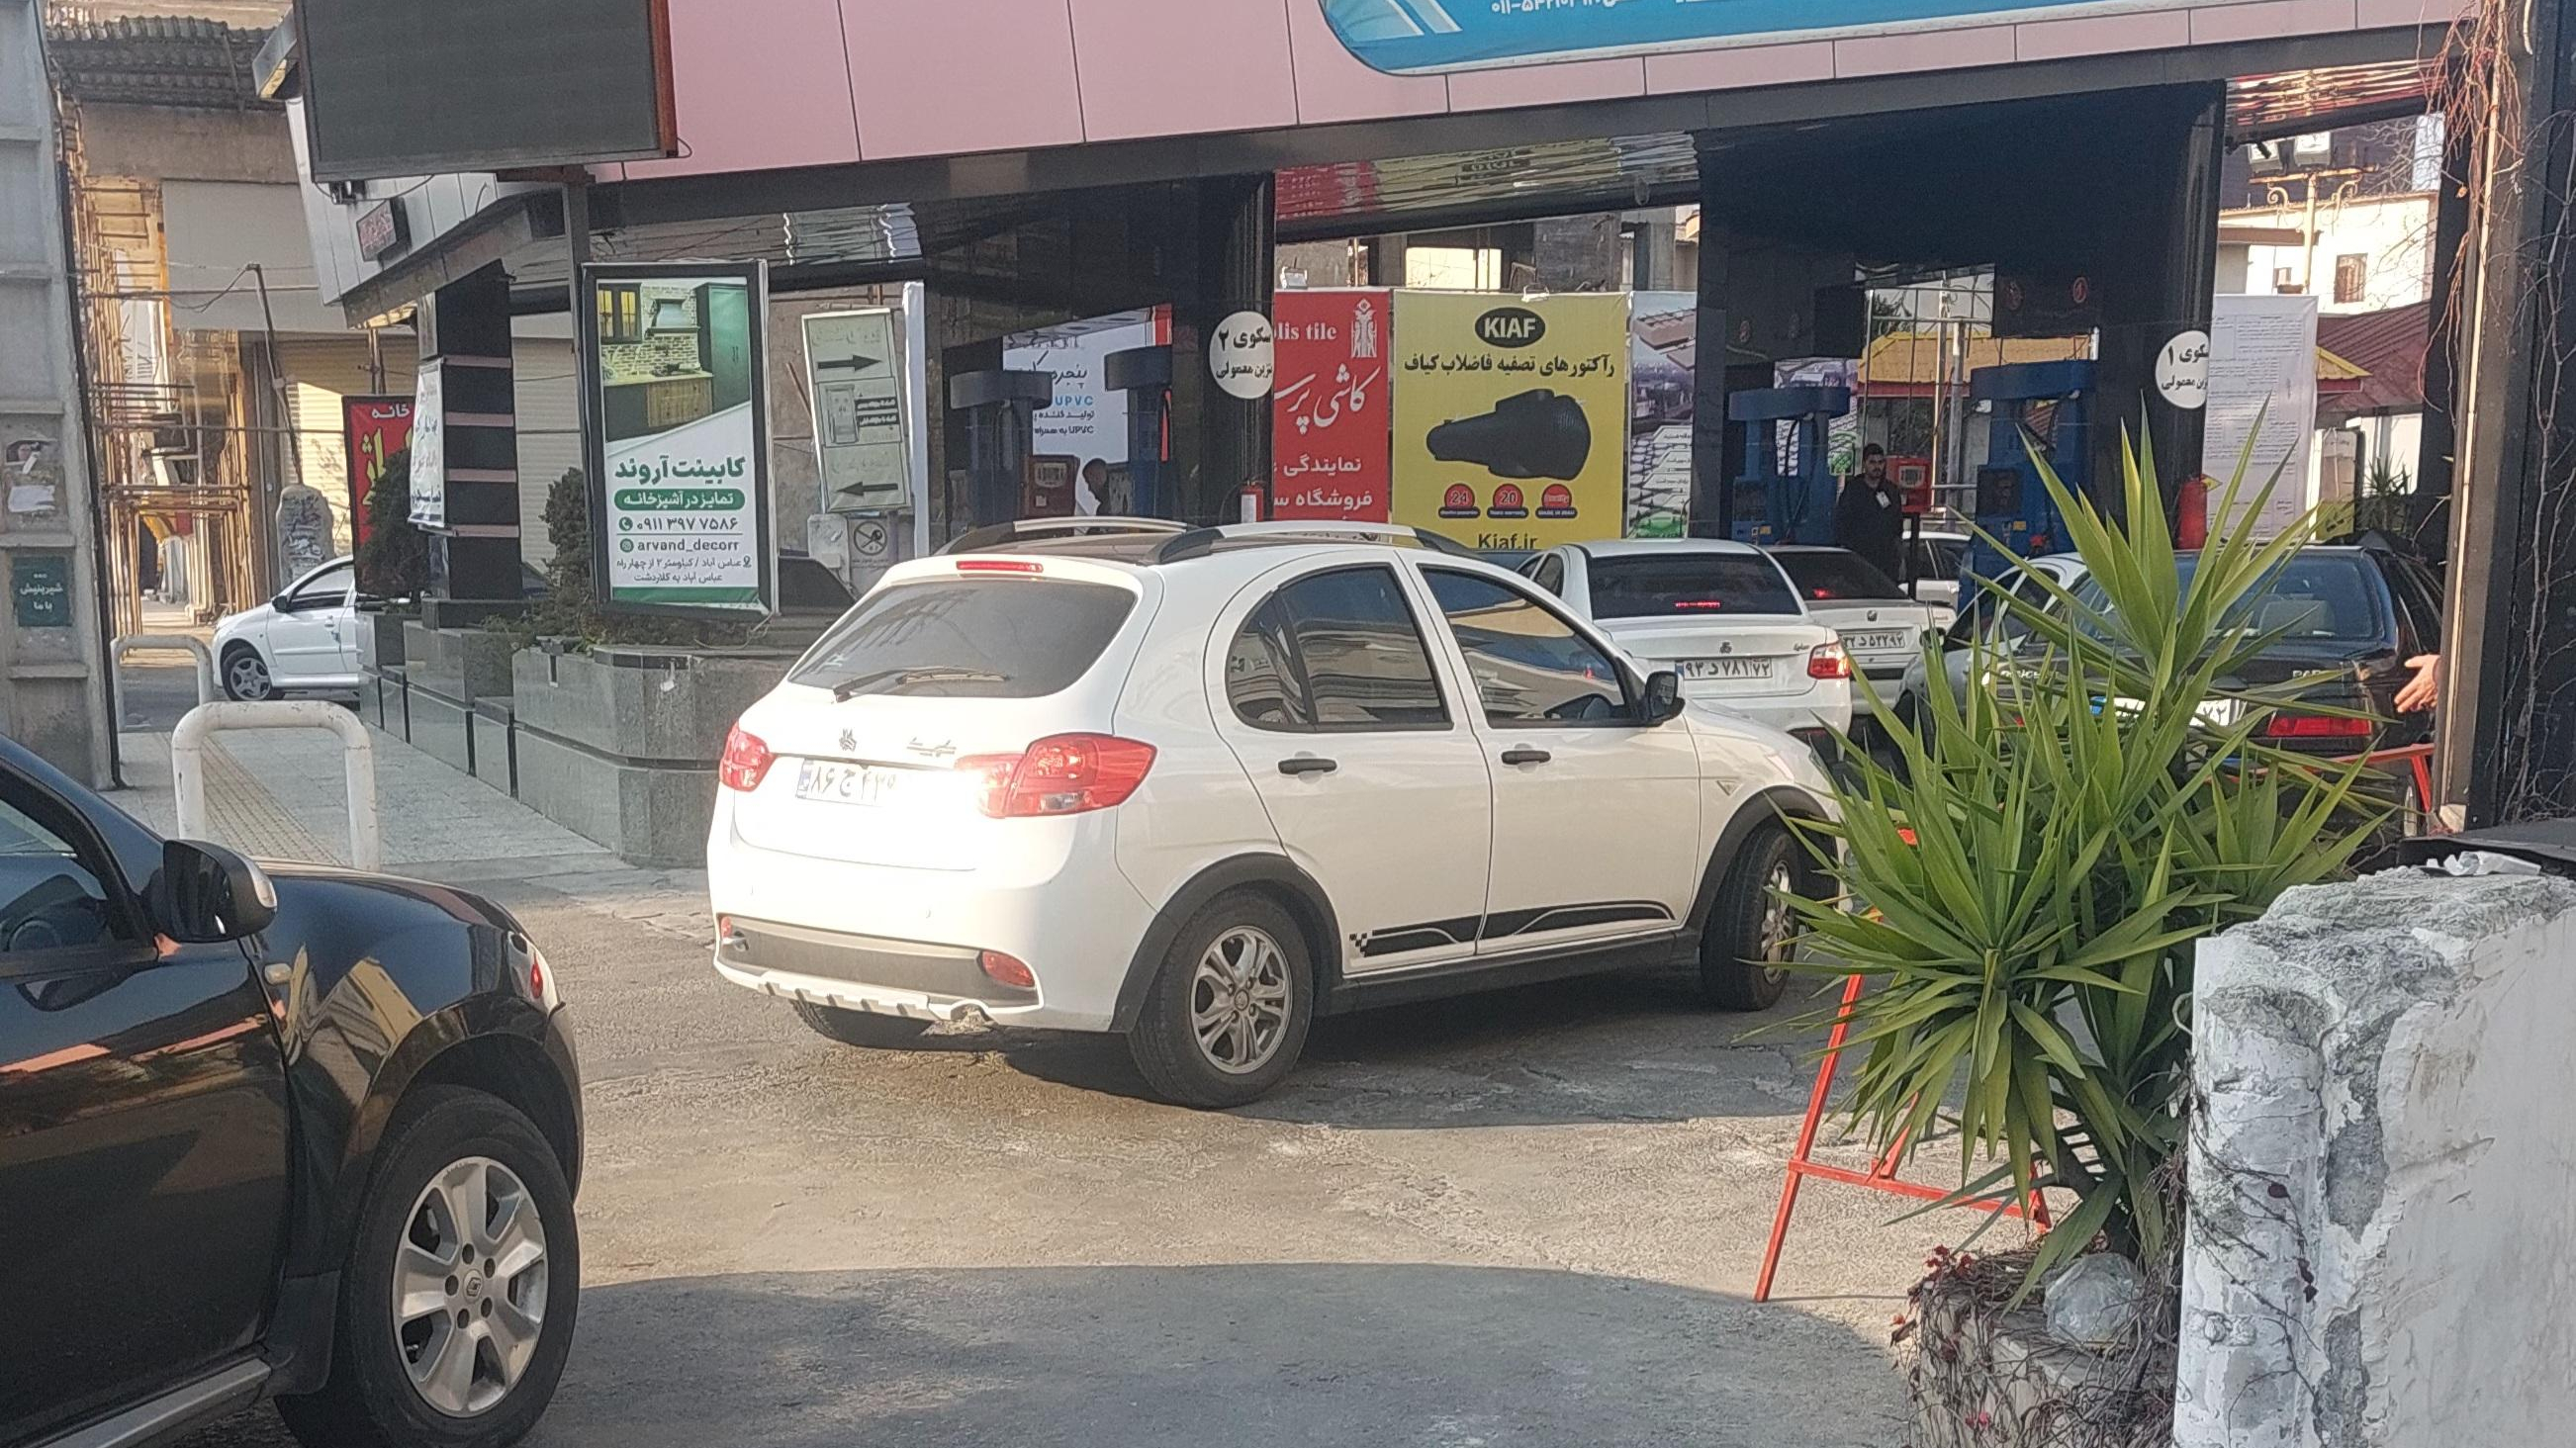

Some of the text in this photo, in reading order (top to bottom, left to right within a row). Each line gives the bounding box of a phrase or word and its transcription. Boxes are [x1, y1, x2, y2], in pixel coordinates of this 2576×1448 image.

[1306, 322, 1337, 340] tile
[1485, 317, 1535, 338] KIAF
[1404, 353, 1439, 375] کیاف
[1440, 354, 1492, 376] فاضلاب
[1497, 355, 1535, 375] تصفیه
[1055, 396, 1094, 407] UPVC
[1068, 424, 1095, 434] UPVC
[614, 455, 746, 485] کابینت آروند
[1283, 453, 1362, 478] نمایندگی
[623, 491, 684, 509] آشپزخانه
[1296, 488, 1373, 511] فروشگاه
[637, 517, 739, 531] ۰۹۱۱ ۳۹۷ ۷۵۸۶
[637, 538, 740, 552] arvand_decorr
[1478, 533, 1538, 551] Kiaf.ir
